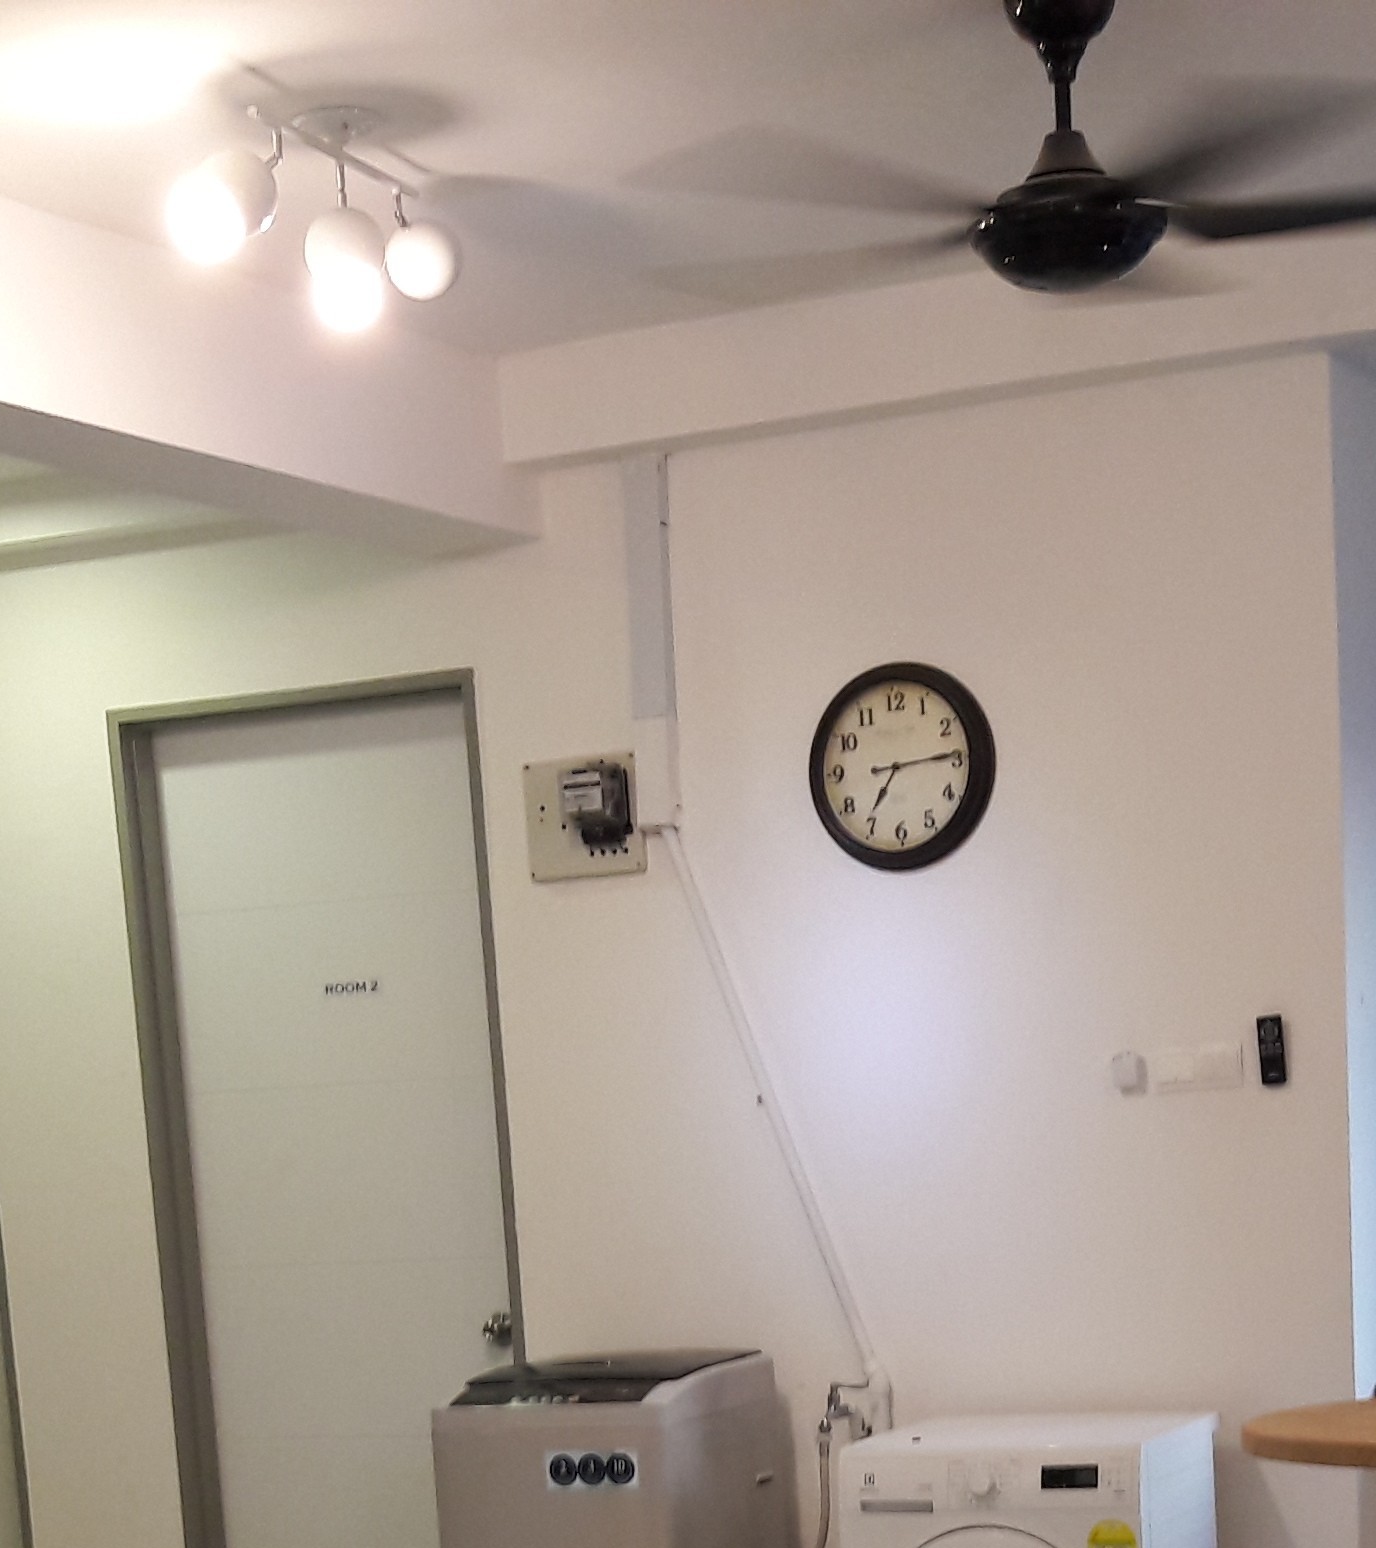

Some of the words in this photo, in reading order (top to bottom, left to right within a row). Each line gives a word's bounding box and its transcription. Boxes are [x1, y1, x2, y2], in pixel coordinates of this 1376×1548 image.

[886, 691, 905, 711] 12
[918, 696, 926, 715] 1
[859, 708, 874, 727] 11
[939, 717, 952, 737] 2
[840, 732, 858, 751] 10
[952, 749, 963, 768] 3
[832, 764, 845, 783] 9
[942, 782, 955, 802] 4
[842, 796, 856, 814] 8
[866, 817, 877, 836] 7
[924, 809, 936, 829] 5
[895, 820, 908, 840] 6
[325, 981, 367, 995] ROOM
